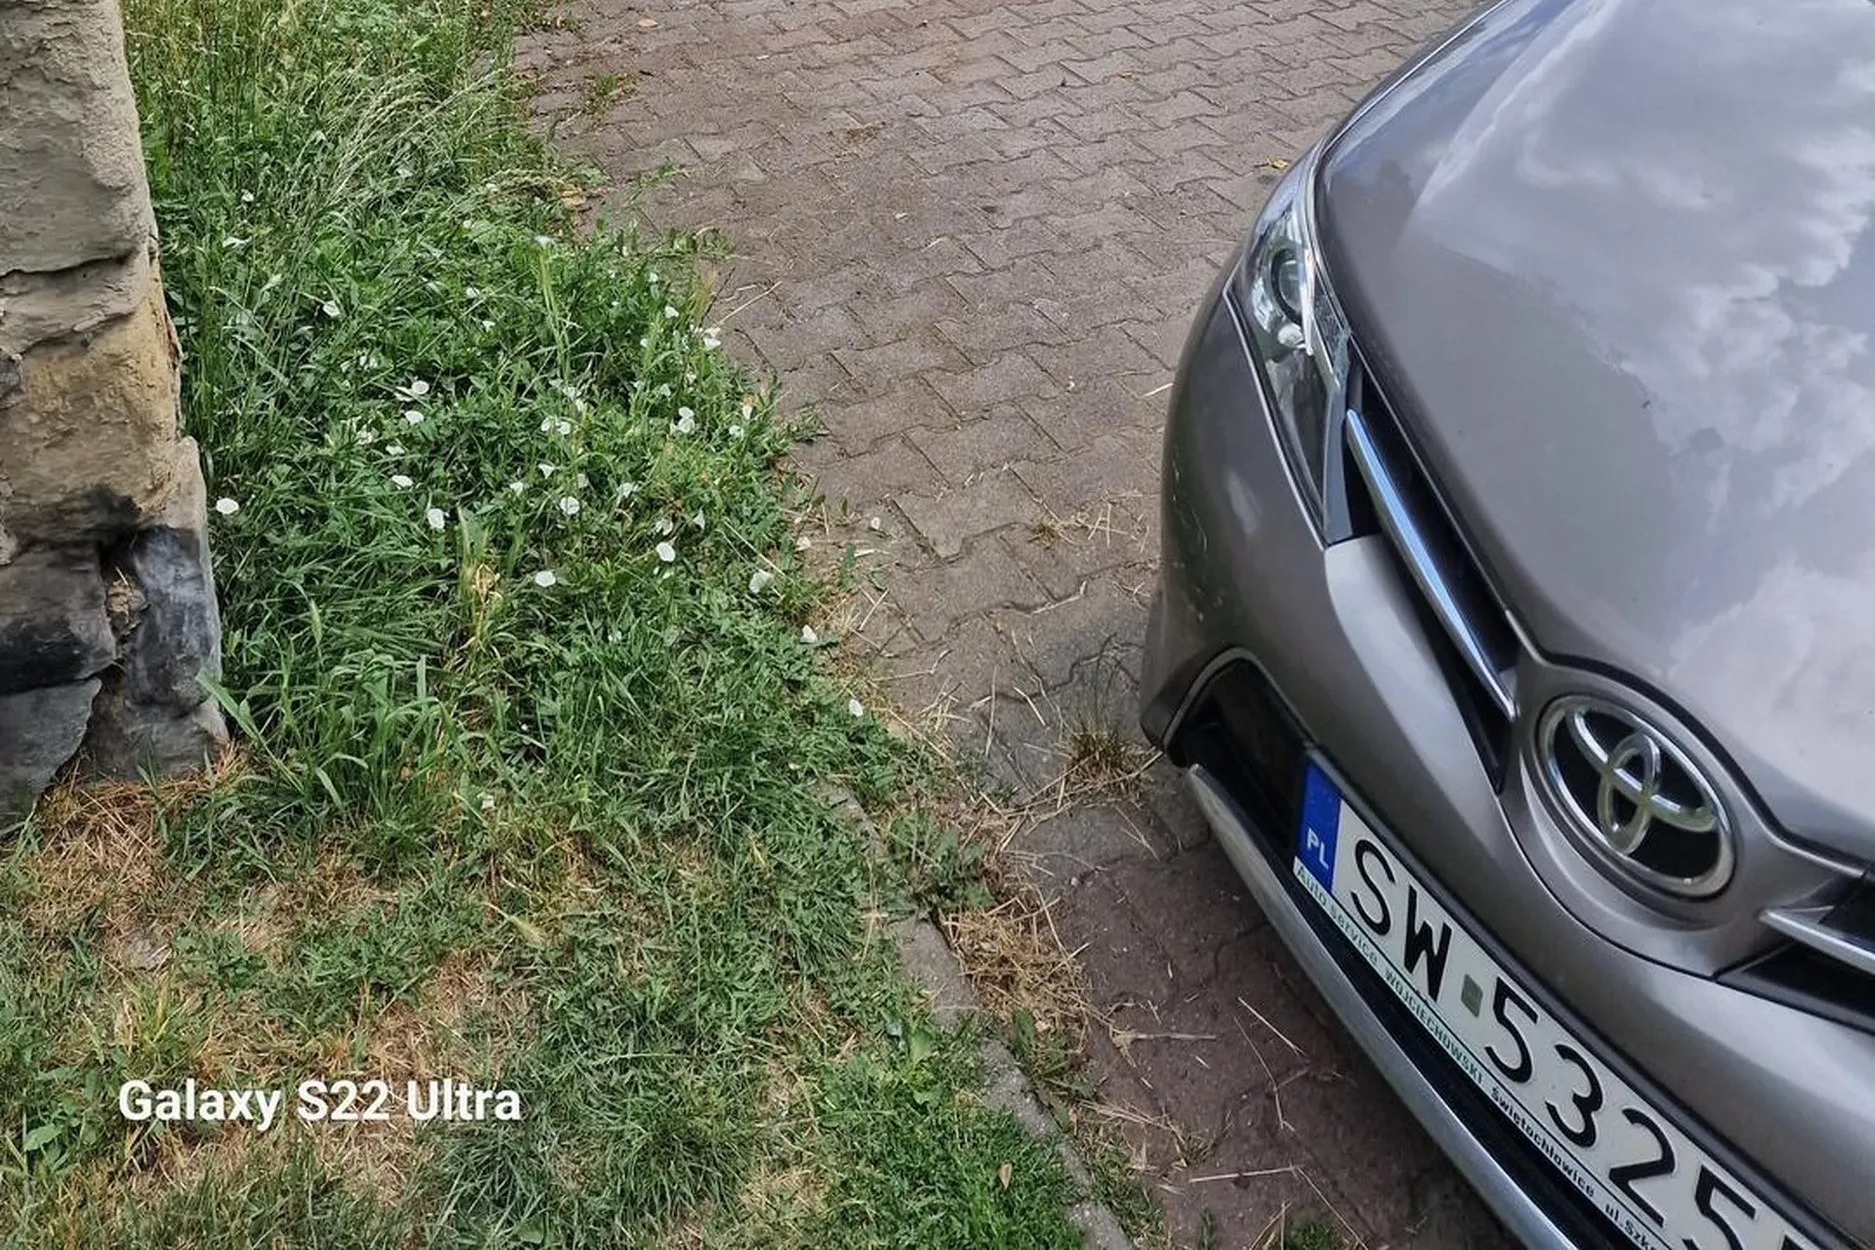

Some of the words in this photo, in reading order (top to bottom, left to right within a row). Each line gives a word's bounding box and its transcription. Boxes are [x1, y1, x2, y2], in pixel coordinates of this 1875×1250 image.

[1307, 828, 1329, 870] PL
[1352, 838, 1452, 1003] SW
[1484, 975, 1818, 1250] 5325
